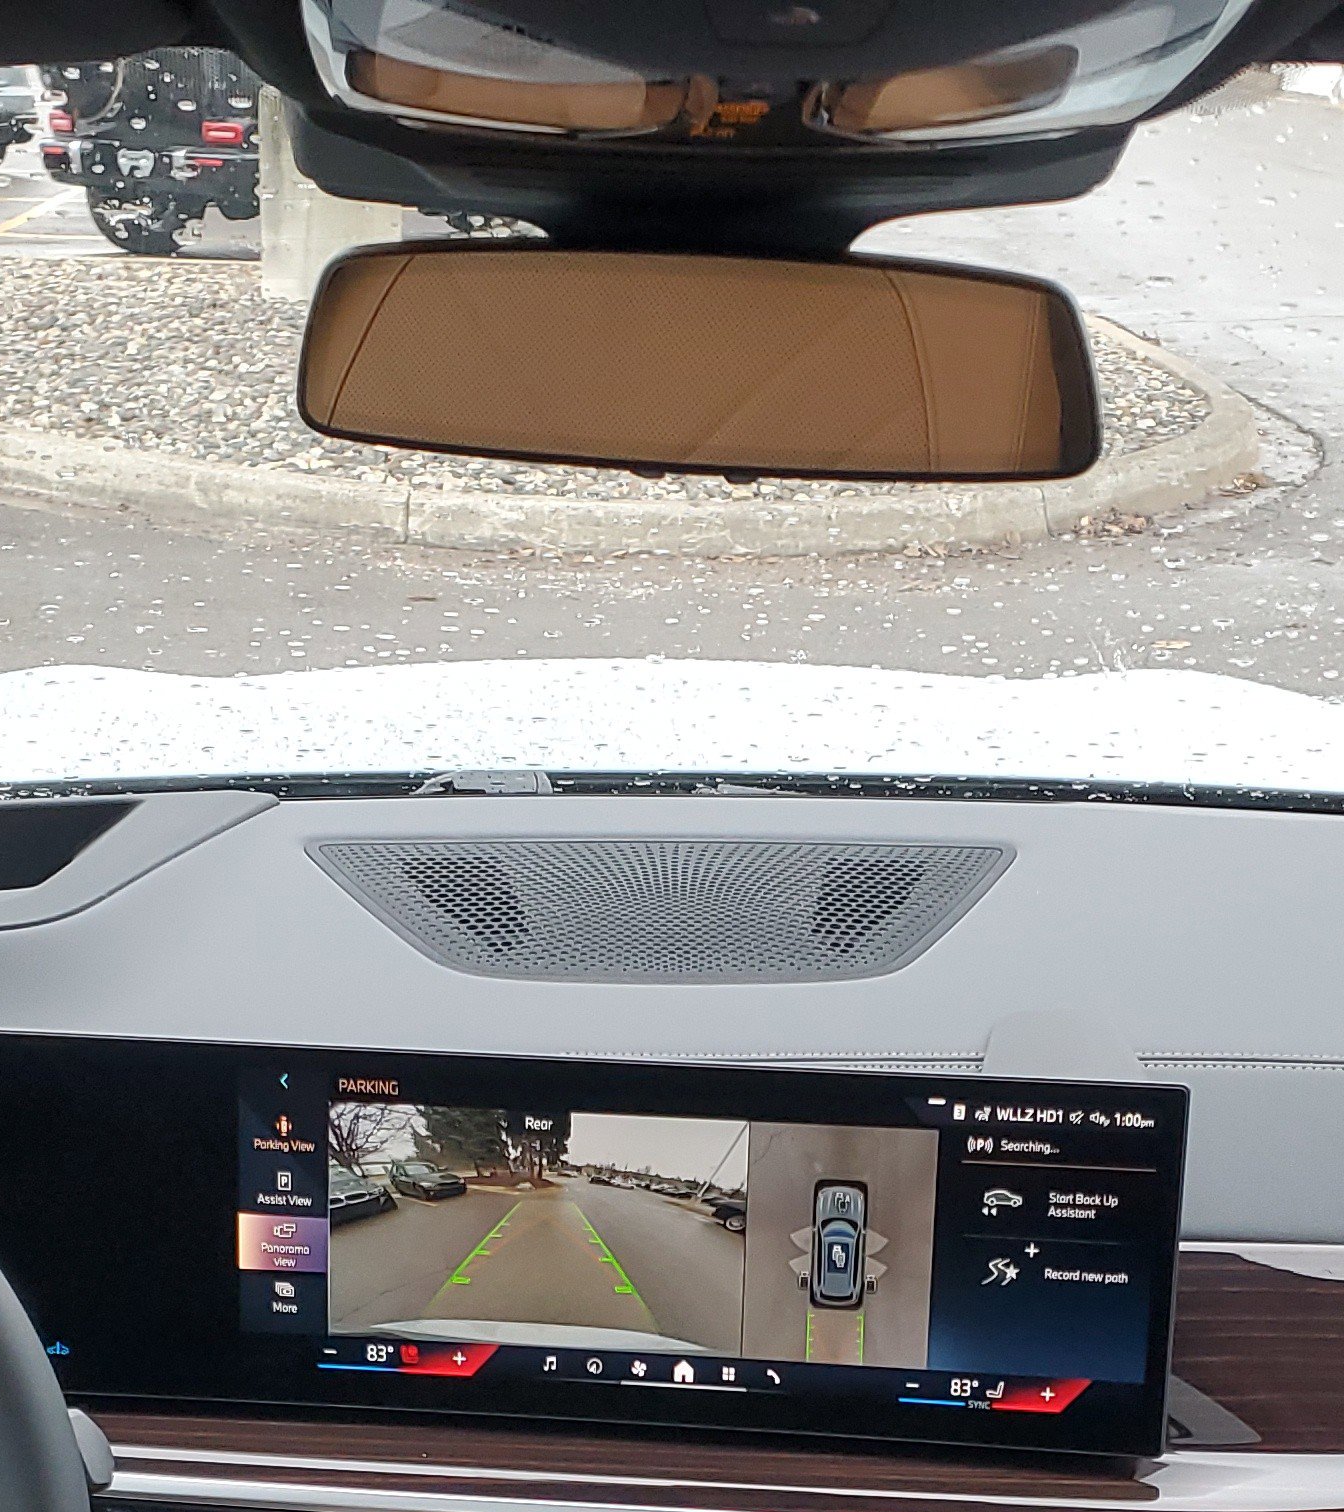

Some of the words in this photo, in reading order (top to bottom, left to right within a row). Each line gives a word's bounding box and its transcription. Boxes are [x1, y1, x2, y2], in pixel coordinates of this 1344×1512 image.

[338, 1078, 399, 1096] PARKING
[996, 1106, 1034, 1122] WLLZ
[1036, 1108, 1063, 1124] HD1
[524, 1116, 554, 1132] Rear
[254, 1139, 289, 1152] Parking
[290, 1140, 315, 1152] View
[257, 1194, 287, 1205] Assist
[288, 1195, 312, 1207] View
[1049, 1192, 1074, 1204] Start
[1076, 1194, 1101, 1206] Back
[1103, 1194, 1119, 1208] Up
[1047, 1206, 1096, 1219] Assistant
[261, 1243, 310, 1255] Panorama
[274, 1257, 296, 1267] view
[1044, 1268, 1080, 1281] Record
[1081, 1272, 1103, 1282] new
[1105, 1273, 1129, 1284] path
[272, 1302, 298, 1314] More
[968, 1401, 991, 1410] SYNC
